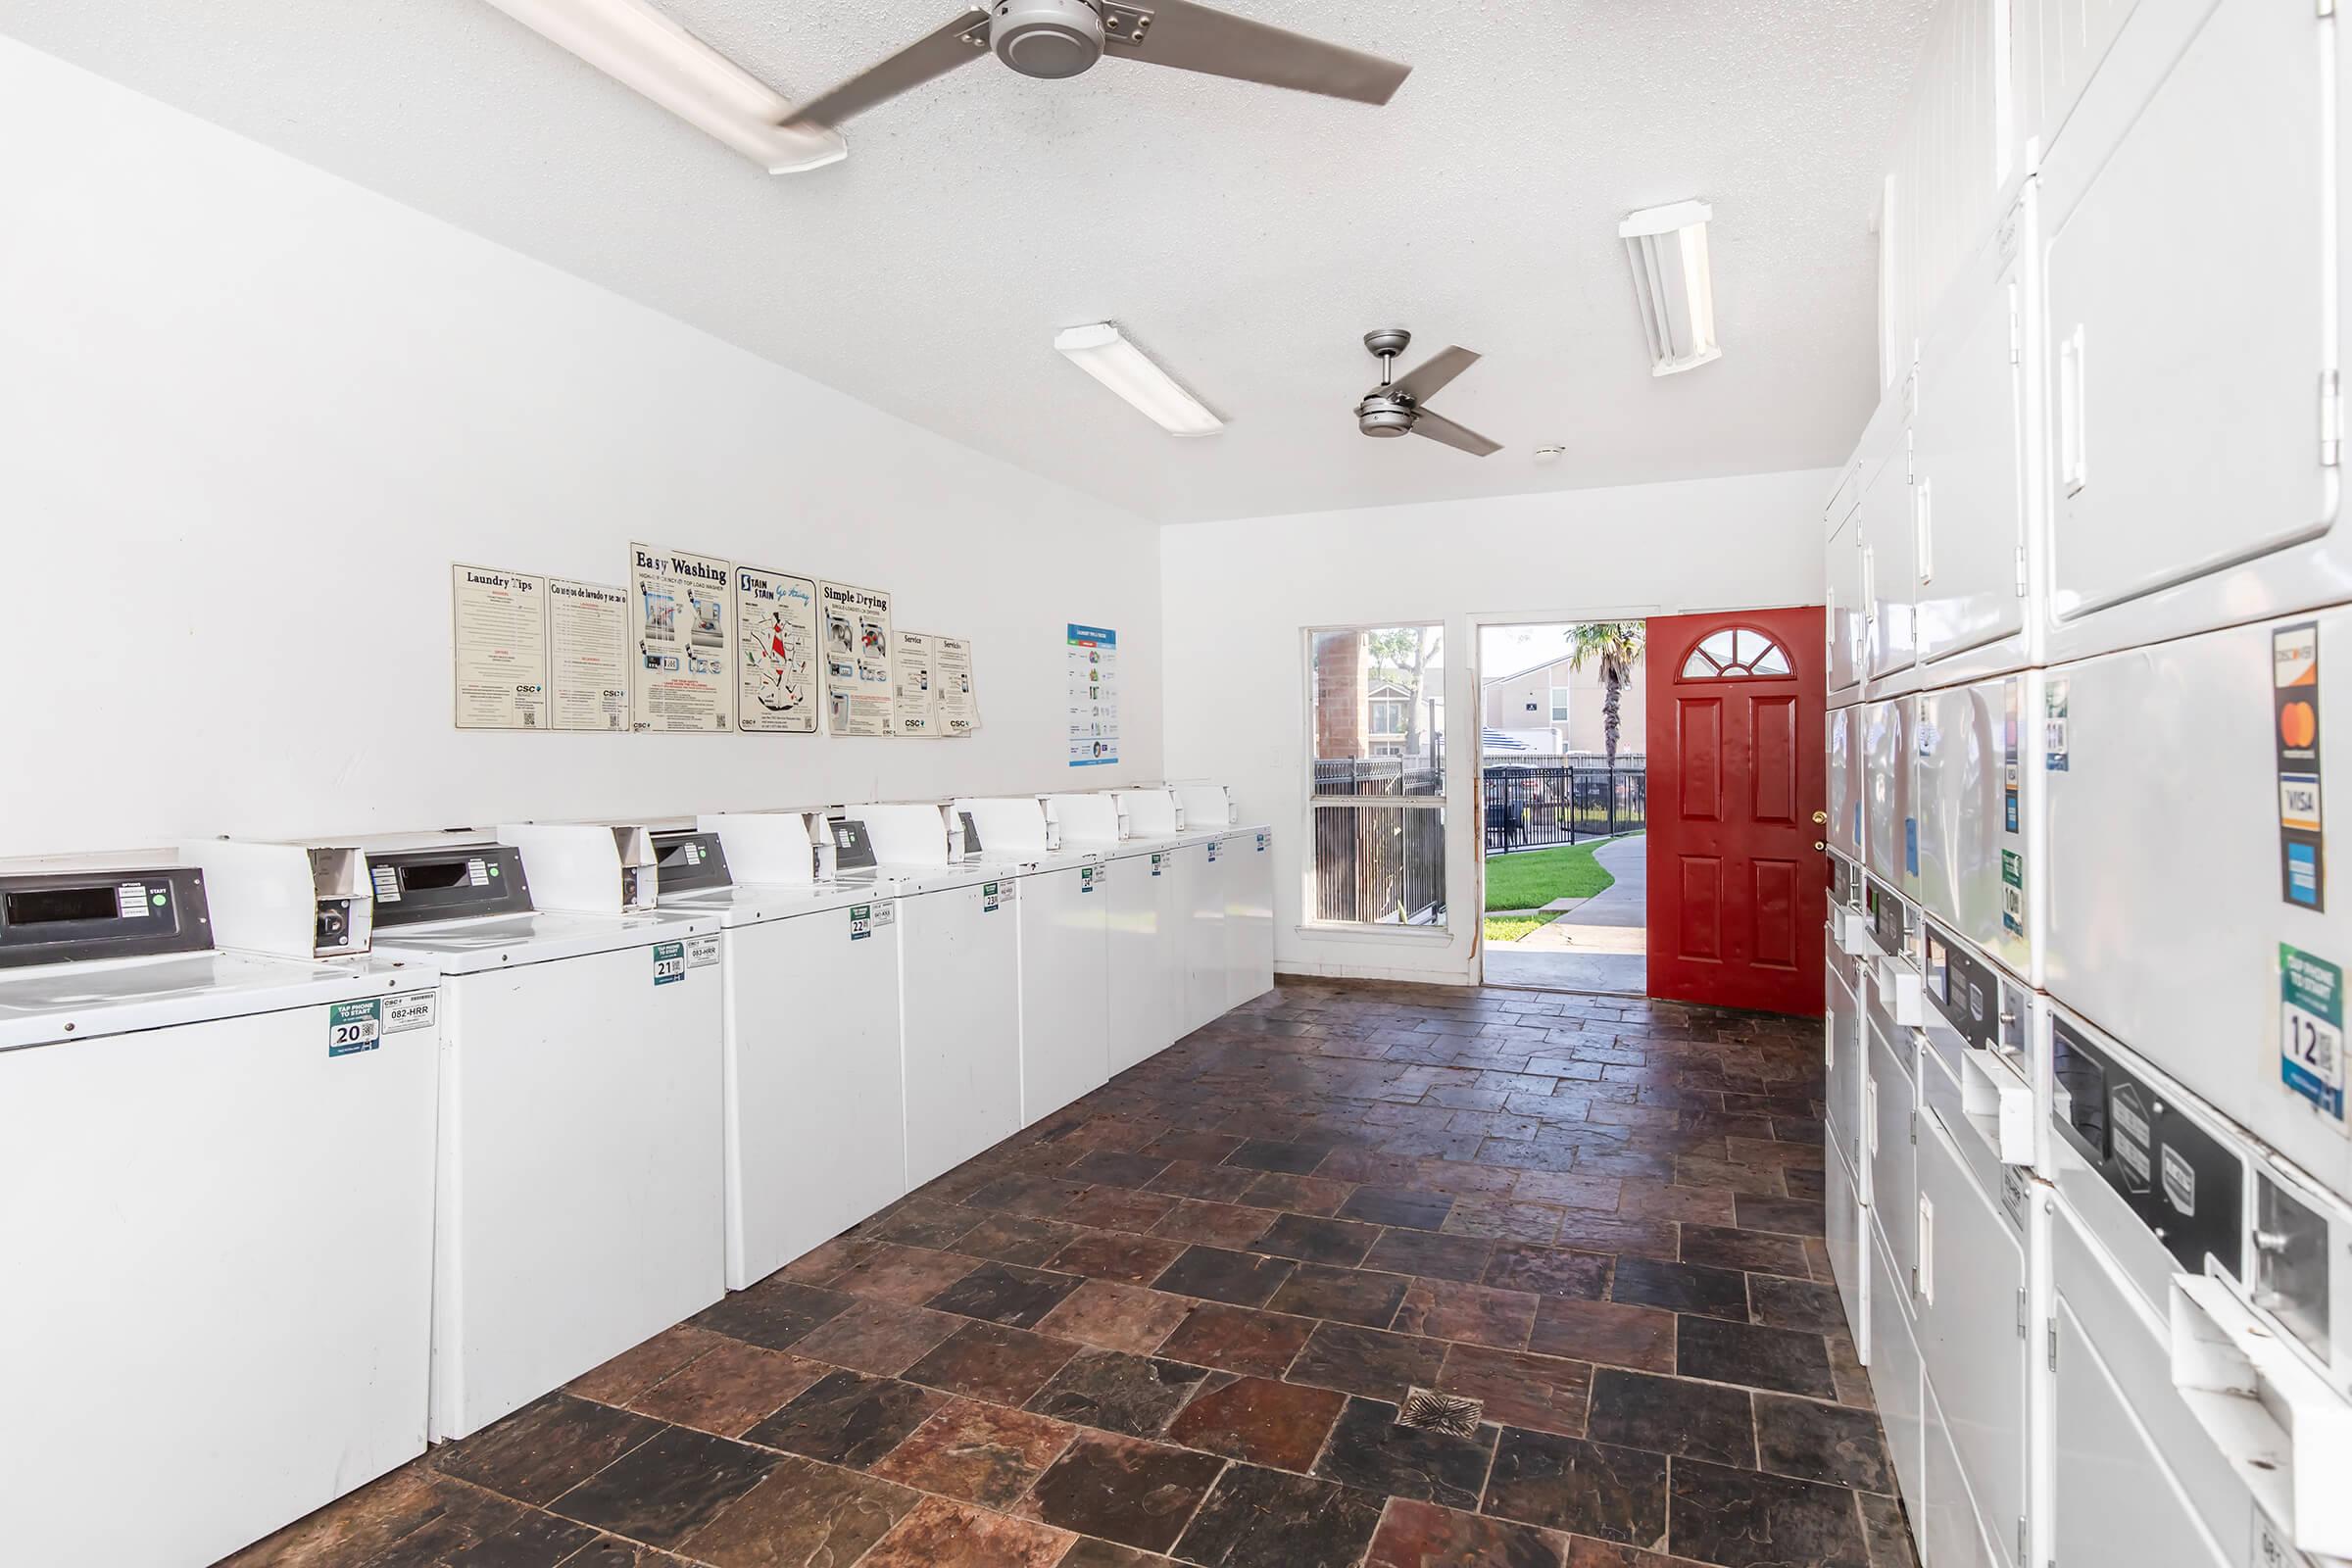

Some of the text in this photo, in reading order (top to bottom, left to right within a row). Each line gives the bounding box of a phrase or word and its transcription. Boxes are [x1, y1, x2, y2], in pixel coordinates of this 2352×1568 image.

[636, 551, 726, 585] Easy Washing
[467, 572, 533, 592] Laundry Tips
[741, 574, 767, 591] STAIN
[578, 588, 585, 598] de
[586, 588, 604, 600] lavado
[604, 594, 608, 603] y
[755, 588, 774, 600] STAIN
[824, 586, 887, 612] Simple Drying
[905, 635, 922, 644] Service
[987, 896, 995, 906] 23
[854, 921, 863, 932] 22
[658, 961, 670, 975] 21
[351, 1007, 371, 1016] START
[352, 1002, 374, 1010] PHONE
[391, 1005, 428, 1019] 082-HRR
[336, 1025, 360, 1044] 20
[2291, 1015, 2317, 1065] 12
